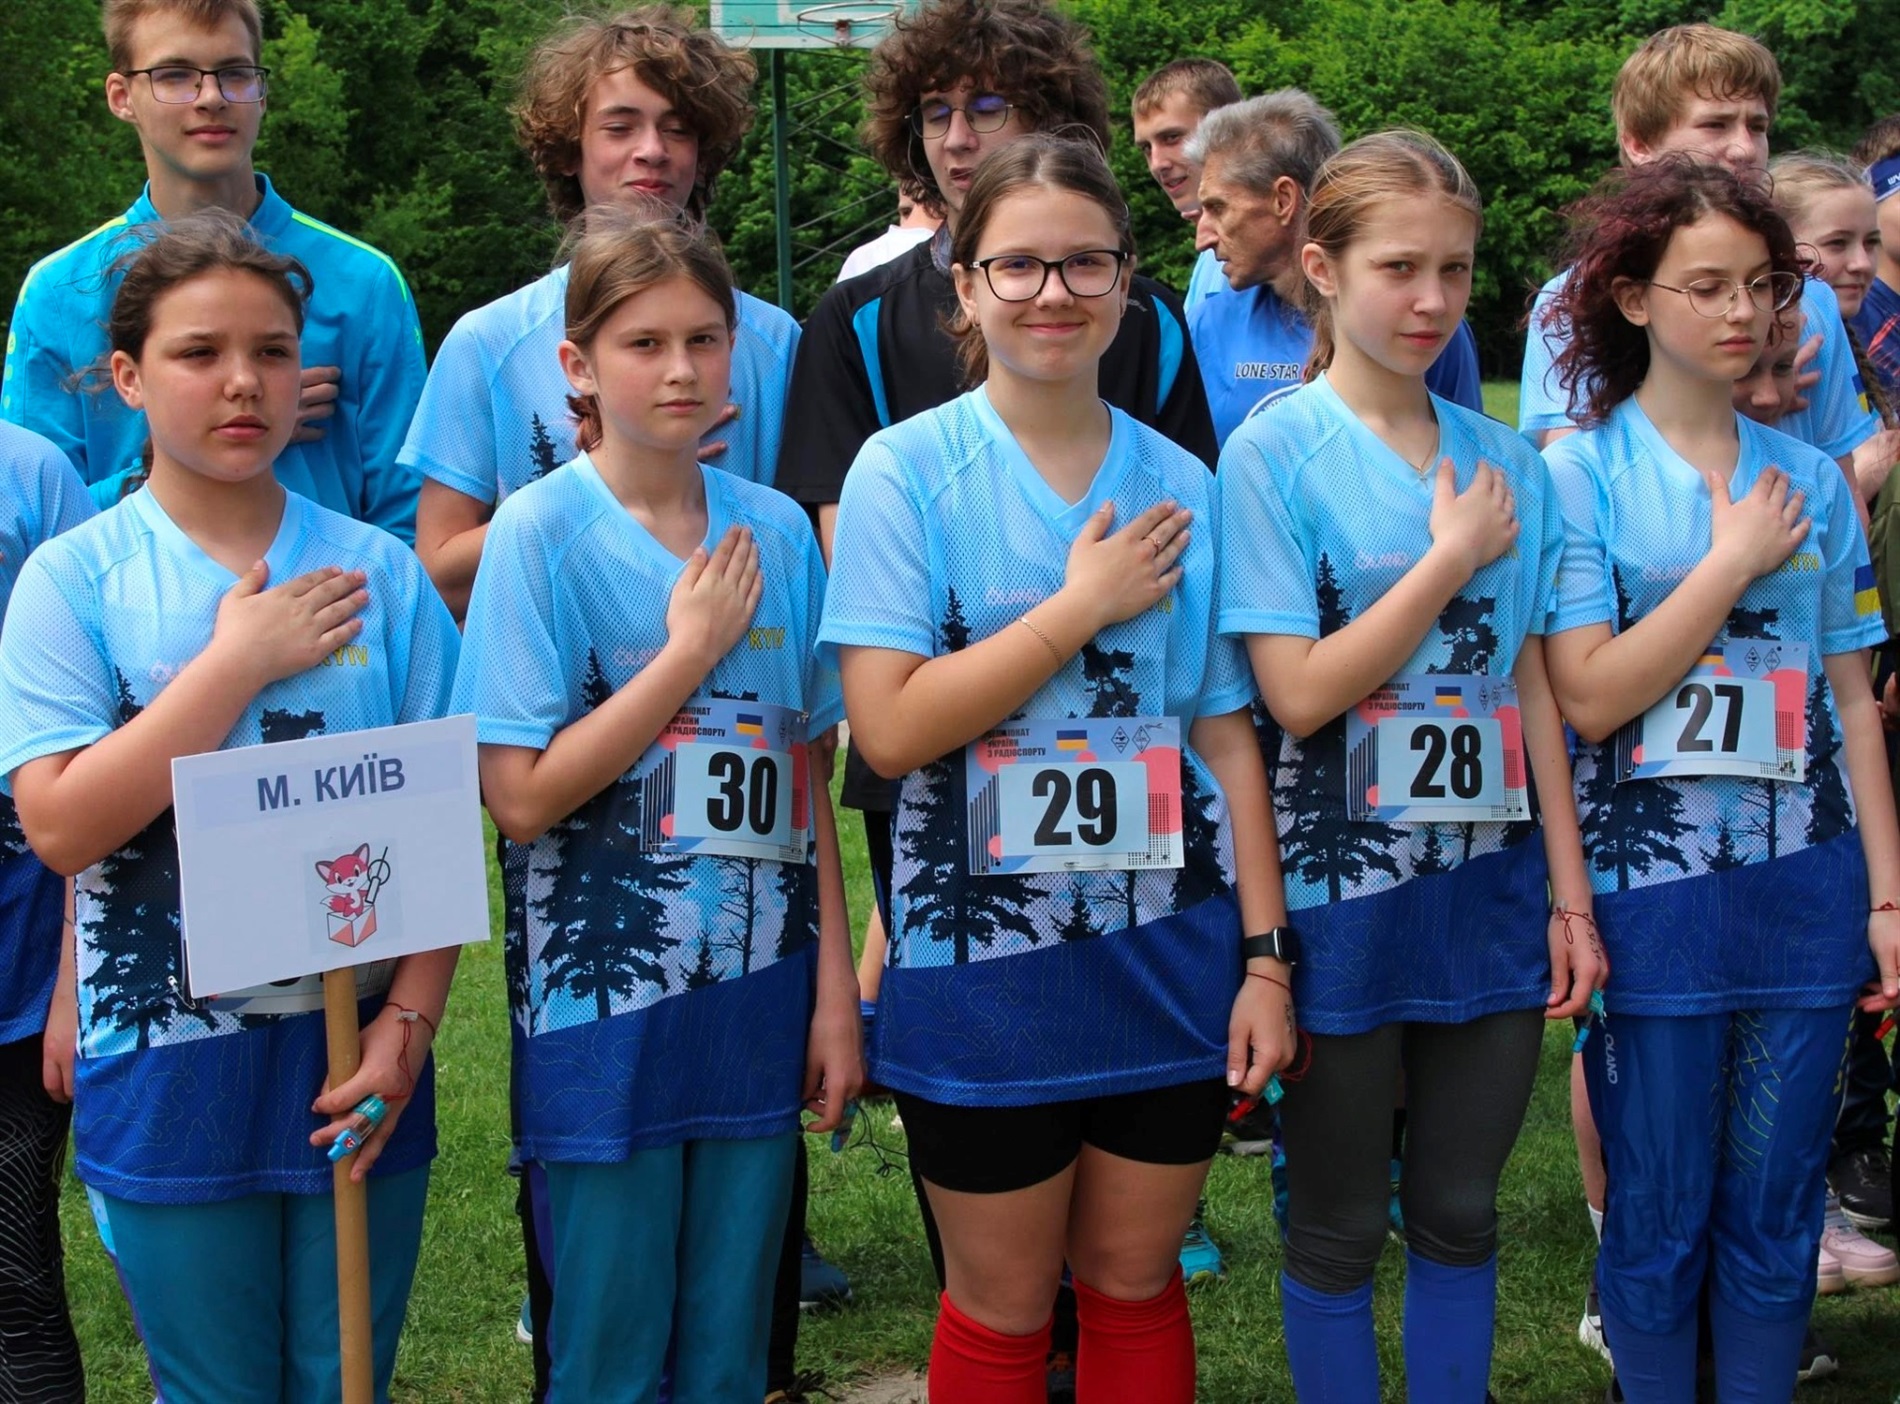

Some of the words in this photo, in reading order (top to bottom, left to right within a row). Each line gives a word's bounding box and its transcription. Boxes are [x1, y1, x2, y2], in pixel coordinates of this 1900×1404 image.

[1235, 363, 1267, 379] LONE
[1269, 364, 1299, 380] STAR
[1780, 553, 1818, 571] YIV
[1374, 702, 1425, 711] РАДІОСПОРТУ
[1676, 683, 1744, 753] 27
[673, 726, 726, 737] РАДІОСПОРТУ
[994, 748, 1046, 757] РАДІОСПОРТУ
[1410, 724, 1483, 799] 28
[257, 774, 301, 811] М.
[314, 752, 405, 802] КИЇВ
[706, 751, 778, 835] 30
[1032, 768, 1118, 846] 29
